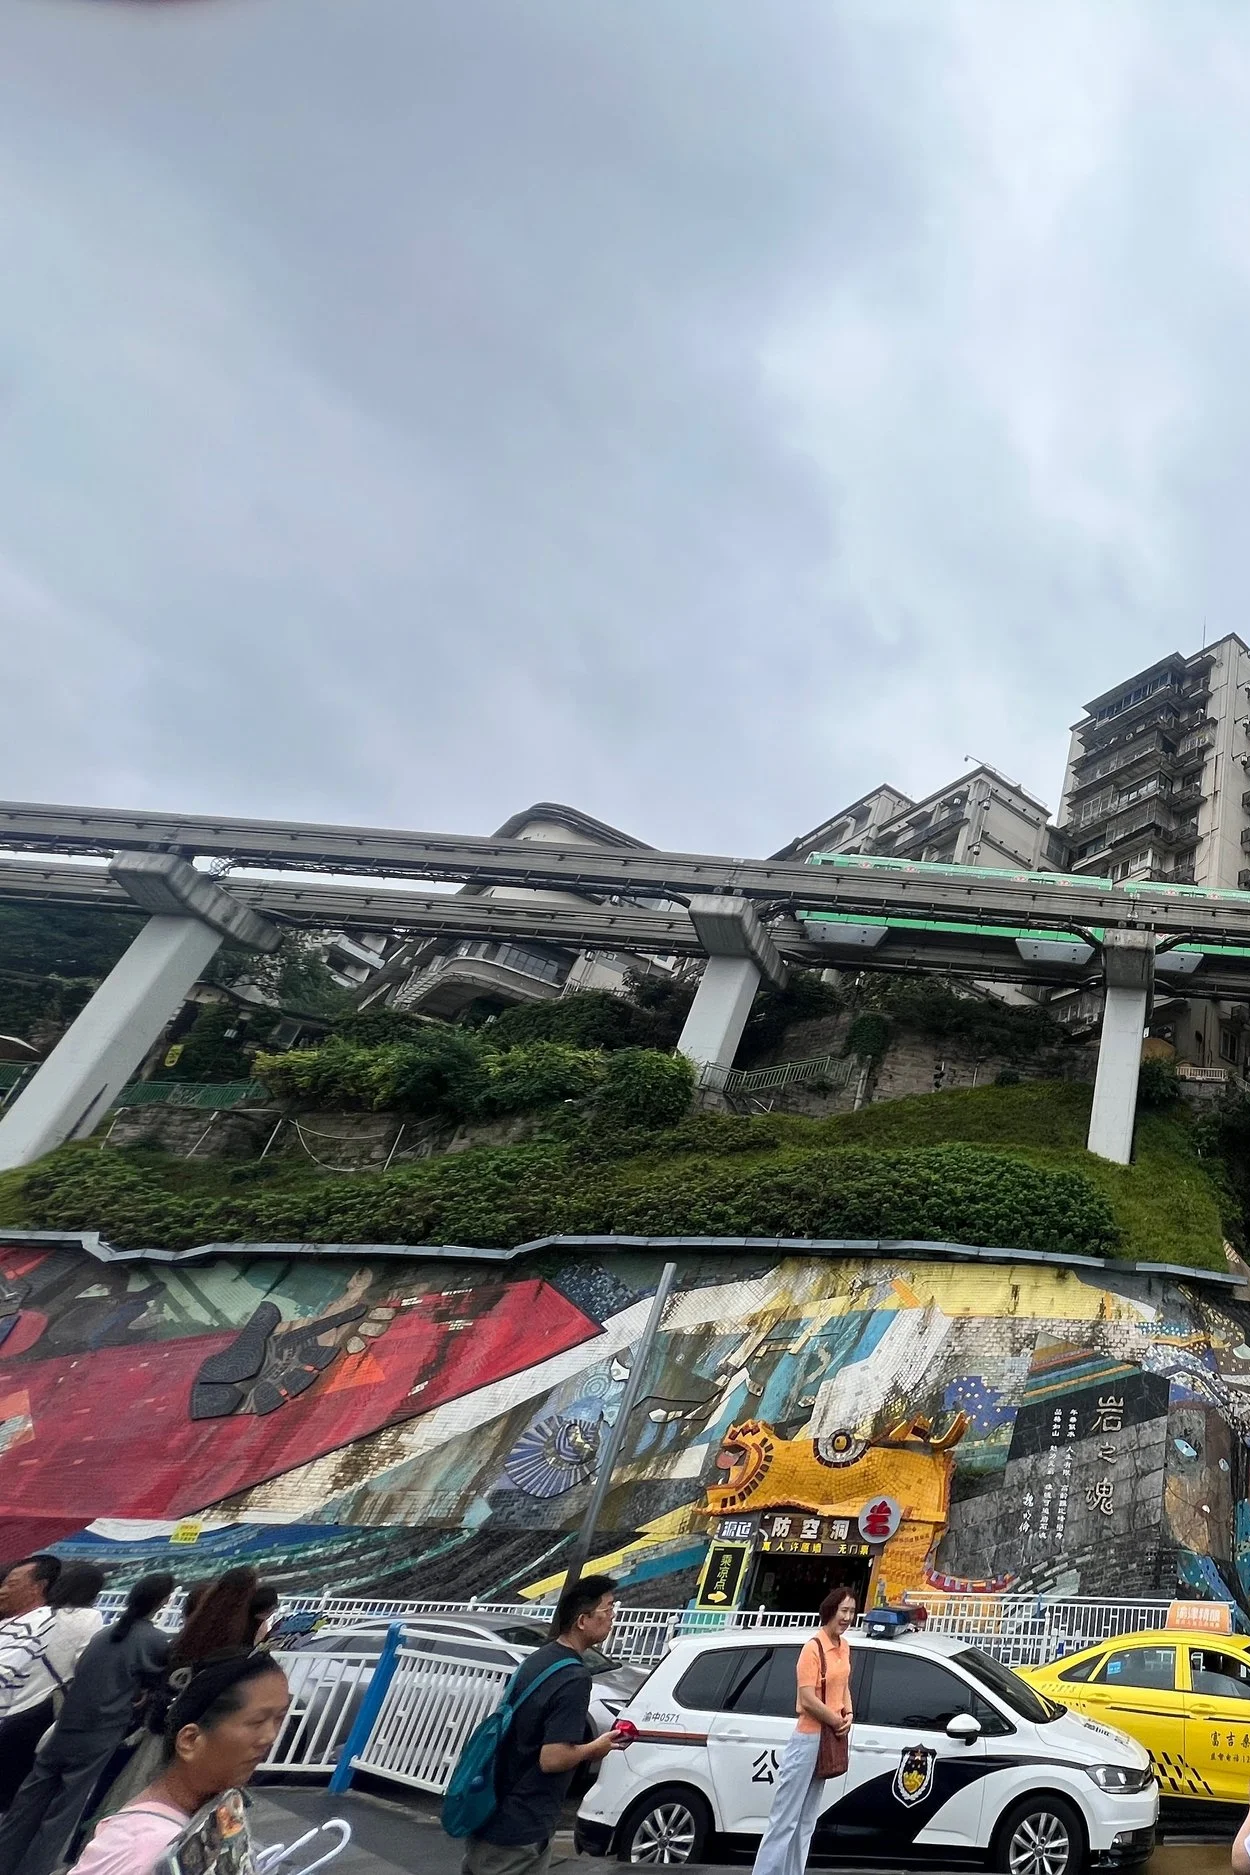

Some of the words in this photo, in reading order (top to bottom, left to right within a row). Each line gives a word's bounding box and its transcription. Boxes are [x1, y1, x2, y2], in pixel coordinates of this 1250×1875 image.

[771, 1516, 850, 1541] 防空洞
[713, 1554, 733, 1591] 乘凉点
[642, 1711, 681, 1723] 渝中0571
